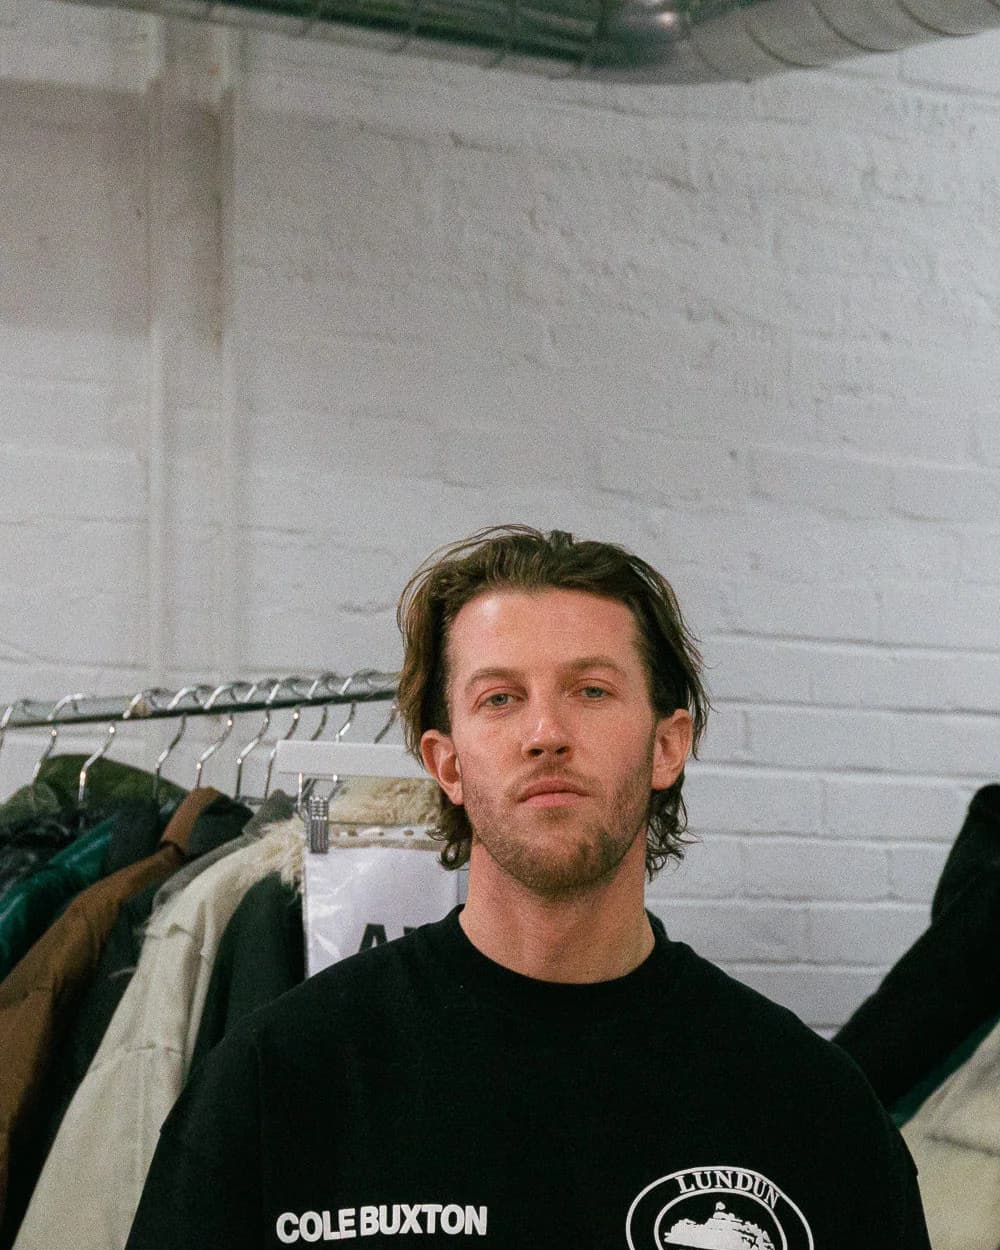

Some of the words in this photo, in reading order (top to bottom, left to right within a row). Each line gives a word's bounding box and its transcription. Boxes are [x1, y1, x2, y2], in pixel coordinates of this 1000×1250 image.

[674, 1170, 780, 1209] LUNDUN
[276, 1208, 357, 1244] COLE
[360, 1204, 488, 1237] BUXTON
